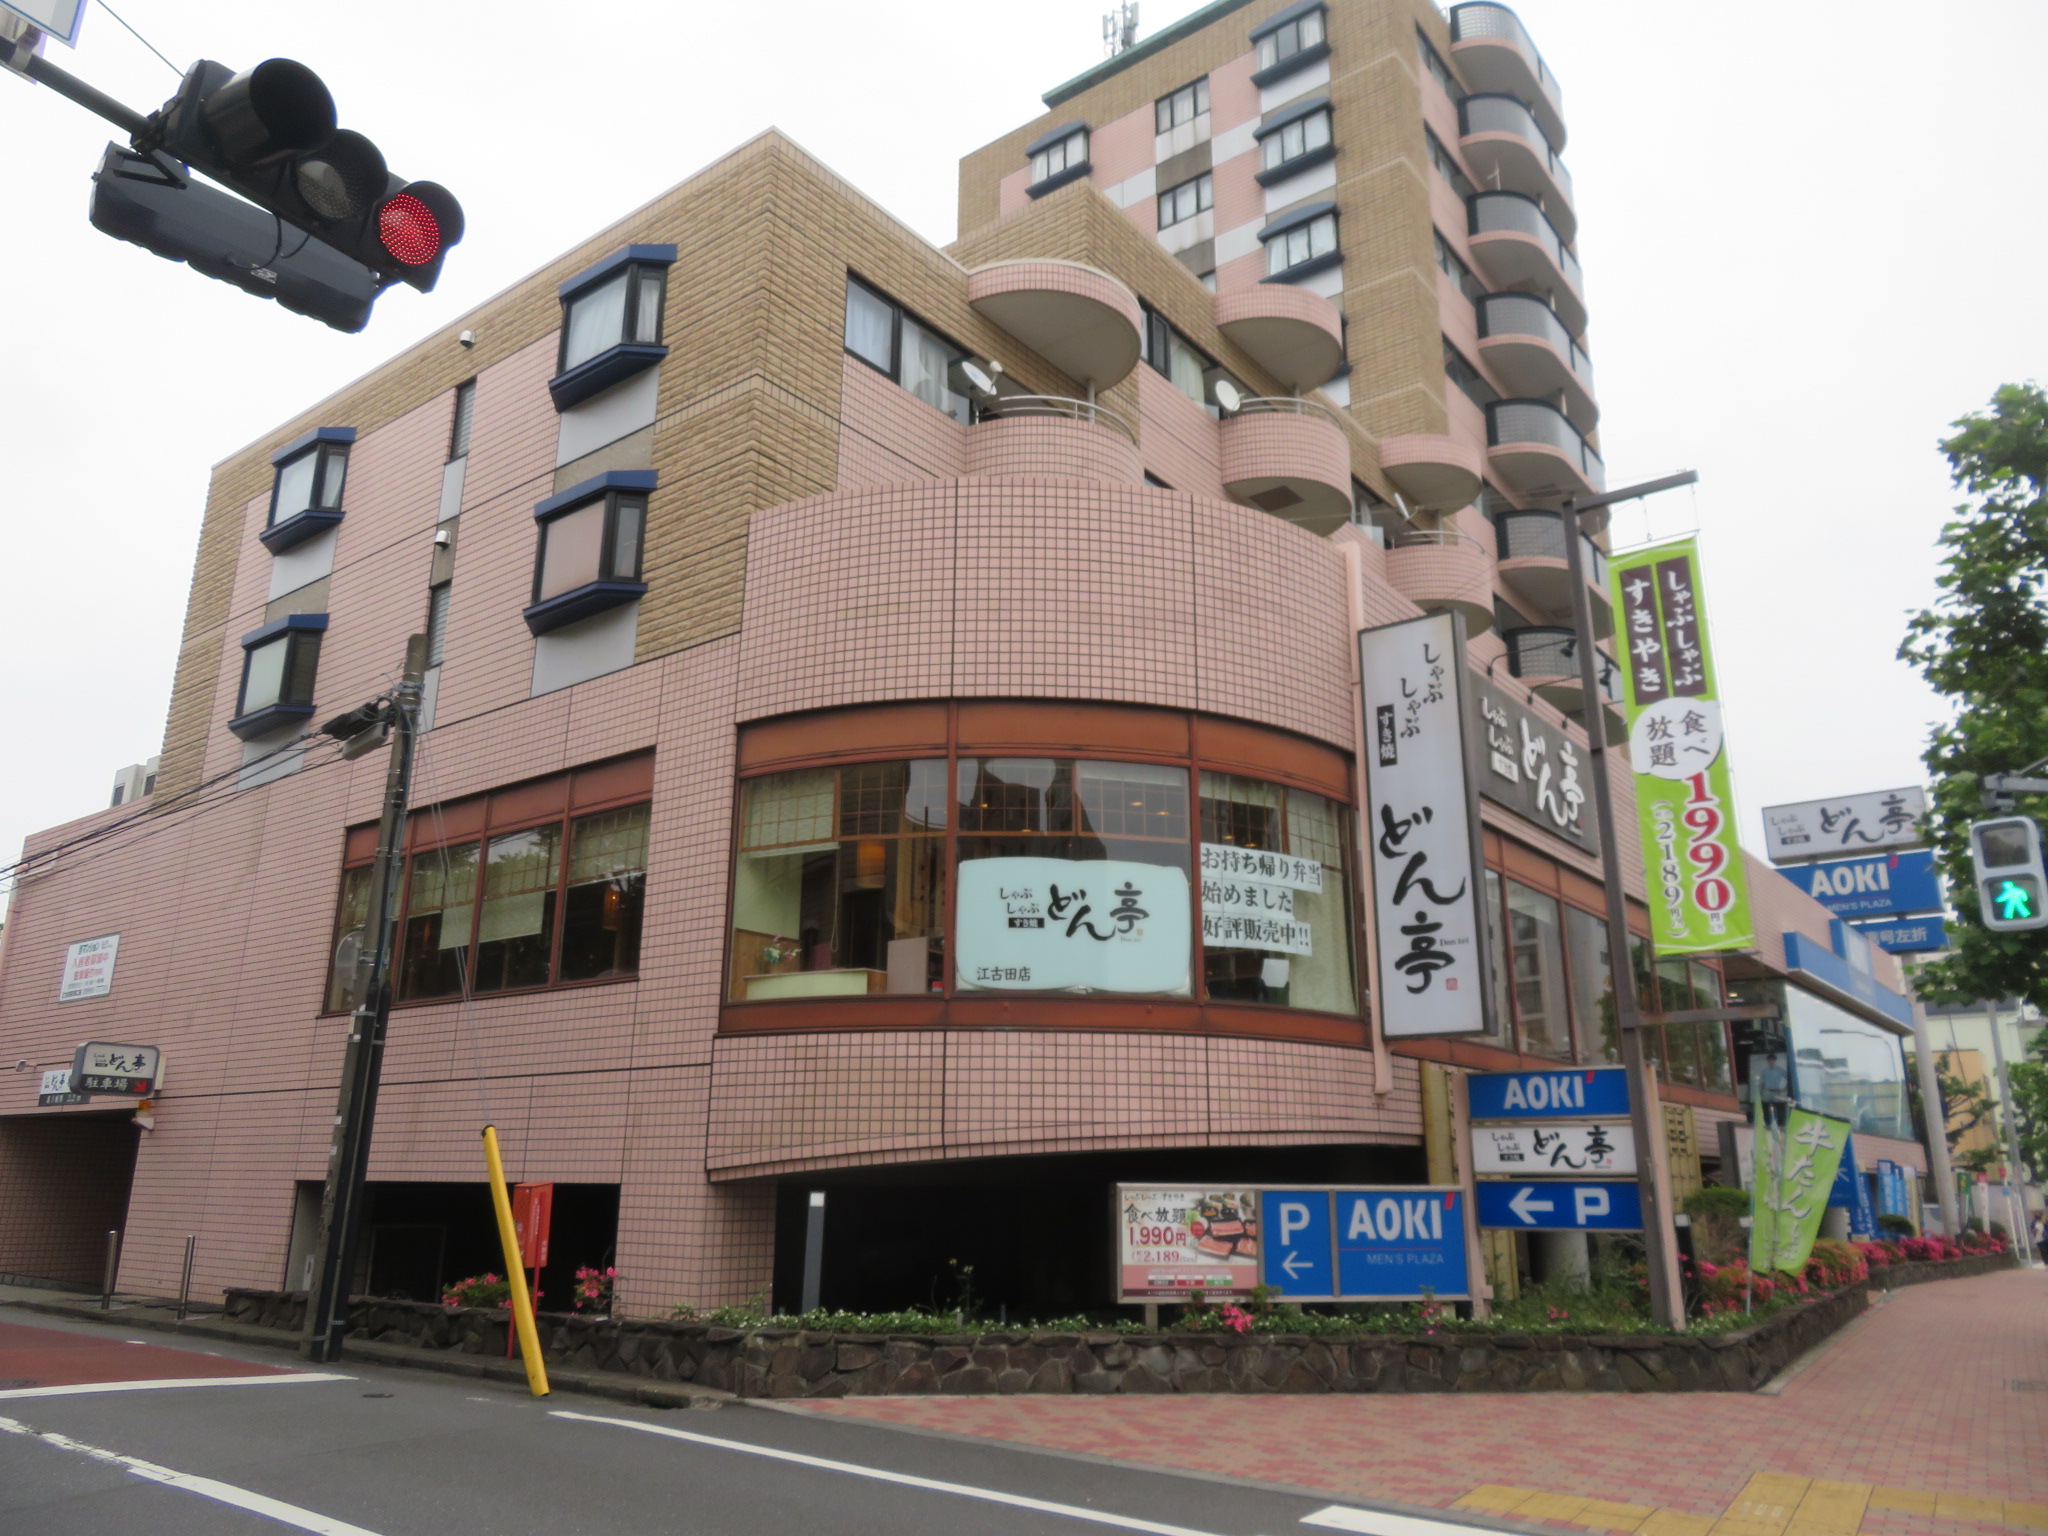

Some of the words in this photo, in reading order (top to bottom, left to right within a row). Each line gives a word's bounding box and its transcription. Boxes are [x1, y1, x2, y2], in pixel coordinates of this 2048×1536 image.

[1624, 579, 1662, 692] すきやき
[1666, 571, 1703, 686] しゃぶしゃぶ
[1423, 643, 1445, 704] しゃぶ
[1400, 677, 1421, 738] しゃぶ
[1820, 793, 1915, 845] どん亭
[1201, 847, 1321, 887] お持ち帰り弁当
[1811, 862, 1890, 898] AOKI
[1000, 888, 1033, 900] しゃぶ
[1006, 902, 1040, 914] しゃぶ
[1048, 881, 1150, 941] どん亭
[1202, 880, 1292, 913] 始めました
[1379, 804, 1466, 994] どん亭
[976, 966, 1031, 982] 江古田店
[109, 1053, 146, 1073] どん亭
[84, 1077, 128, 1090] 駐車場
[1503, 1076, 1585, 1110] AOKI
[1533, 1125, 1616, 1169] どん亭
[1125, 1203, 1188, 1225] 食べ放題
[1280, 1203, 1310, 1246] P
[1347, 1198, 1443, 1241] AOKI
[1574, 1187, 1610, 1225] P
[1367, 1254, 1403, 1264] MEN'S
[1407, 1254, 1444, 1264] PLAZA
